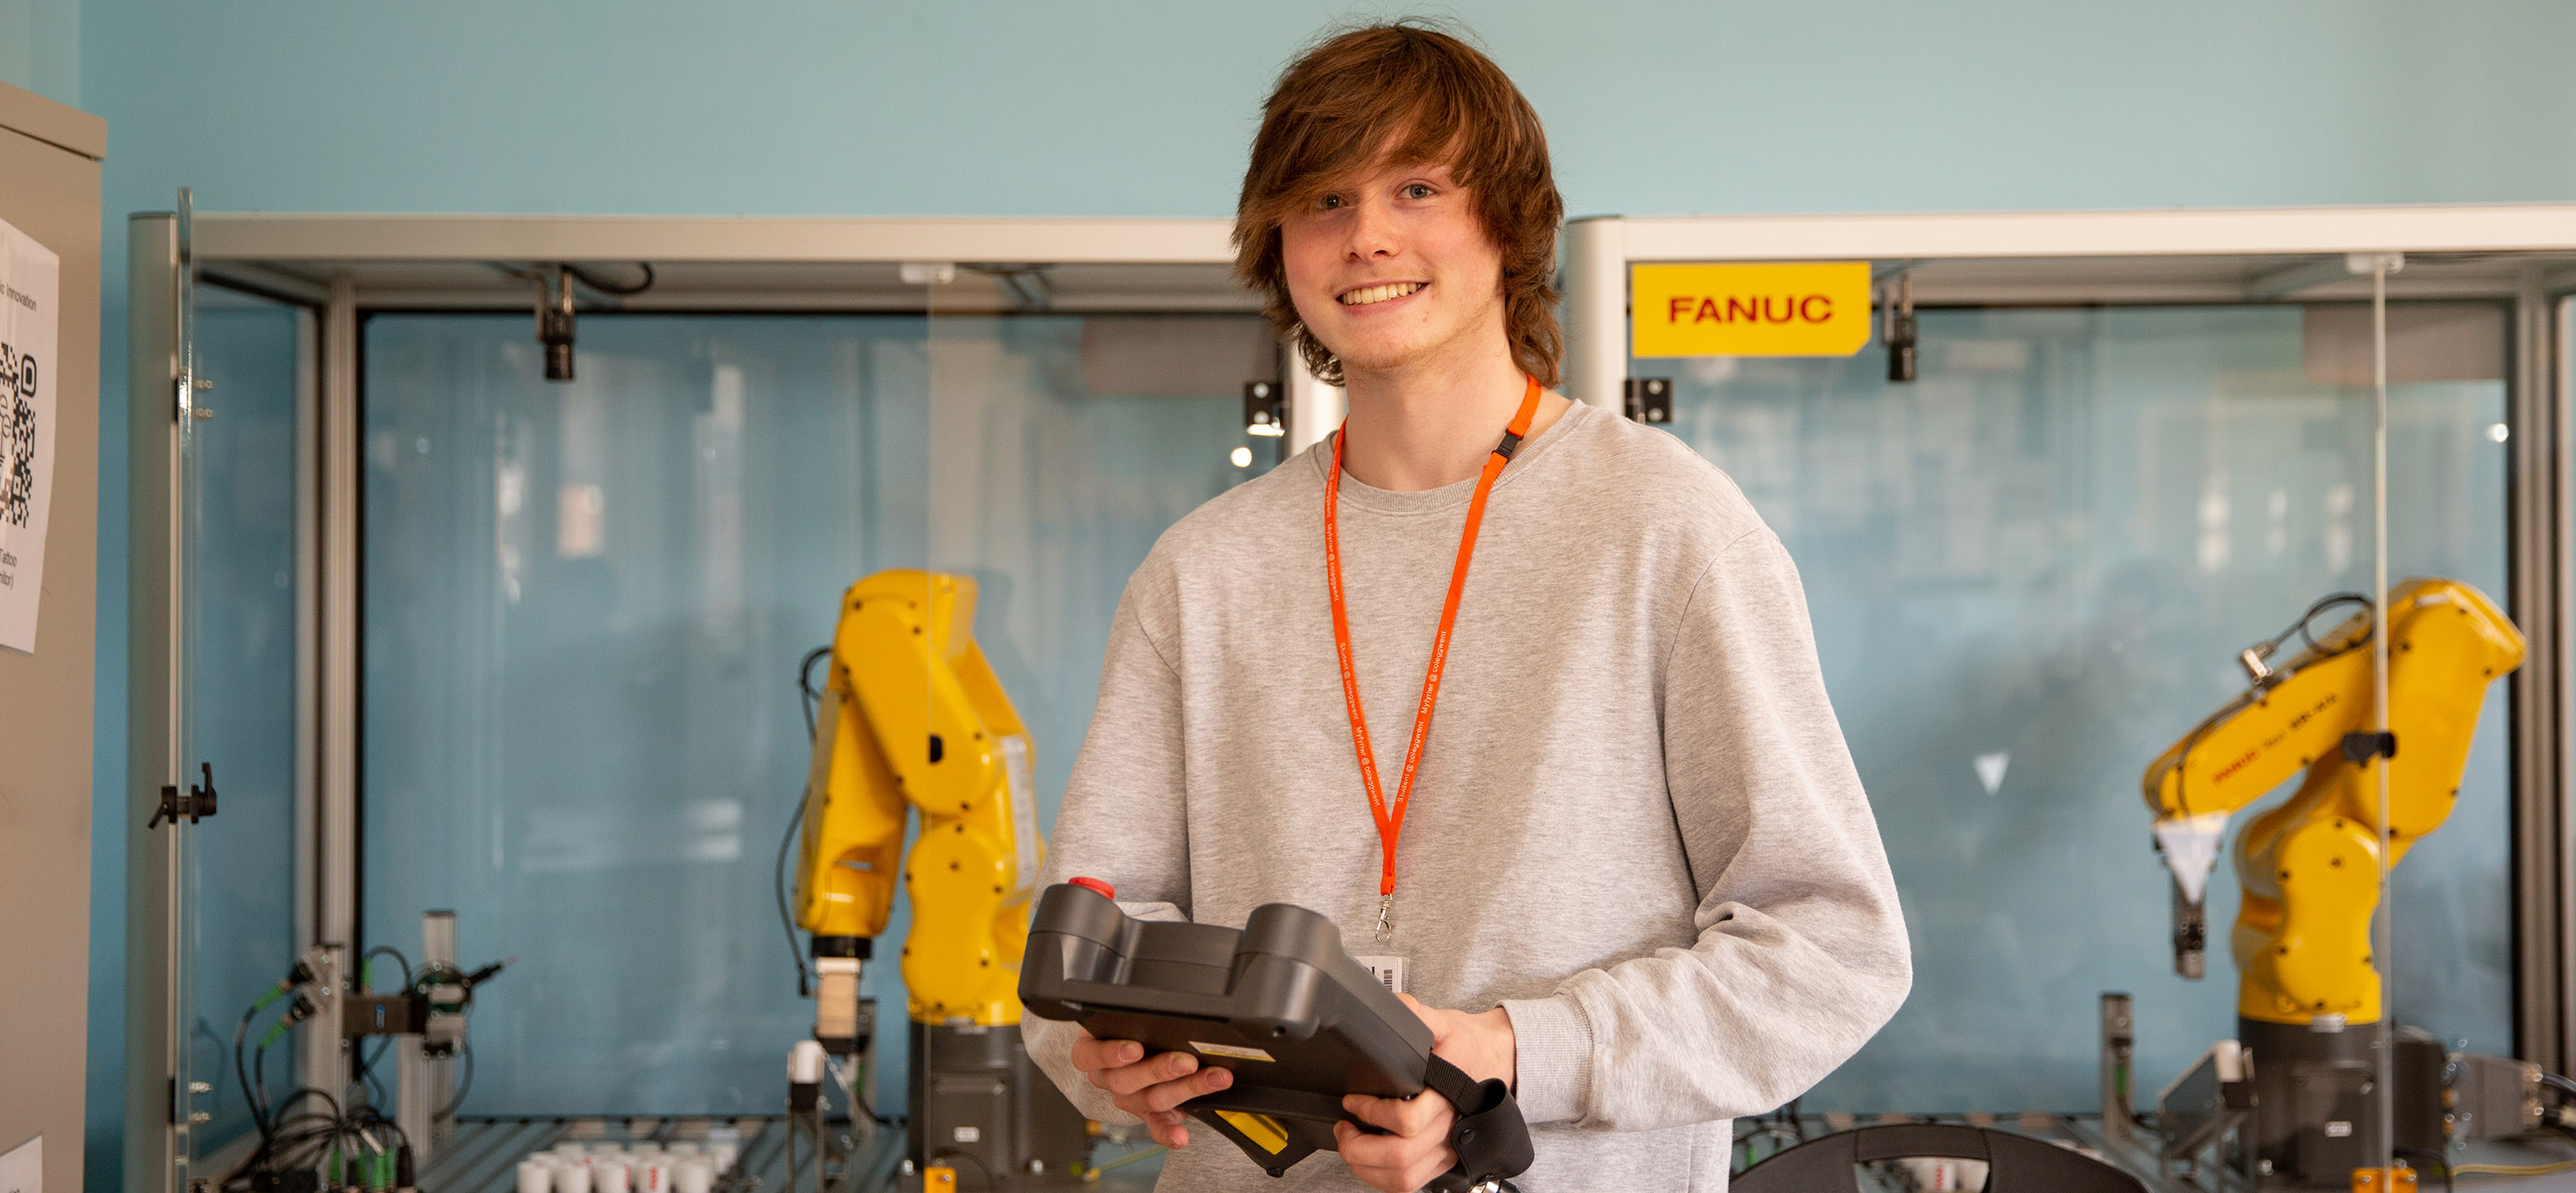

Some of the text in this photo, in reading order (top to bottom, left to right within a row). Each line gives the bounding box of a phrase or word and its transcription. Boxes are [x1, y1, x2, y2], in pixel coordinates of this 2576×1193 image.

[6, 282, 37, 312] Innovation
[1667, 293, 1834, 324] FANUC
[1328, 553, 1336, 562] @
[1330, 562, 1339, 602] coleggwent
[1340, 643, 1359, 720] Student @ coleggwent
[1420, 631, 1447, 714] Myfyriwr @ coleggwent
[1355, 726, 1381, 807] Myfyriwr @ coleggwent
[1397, 721, 1424, 803] Student @ coleggwent
